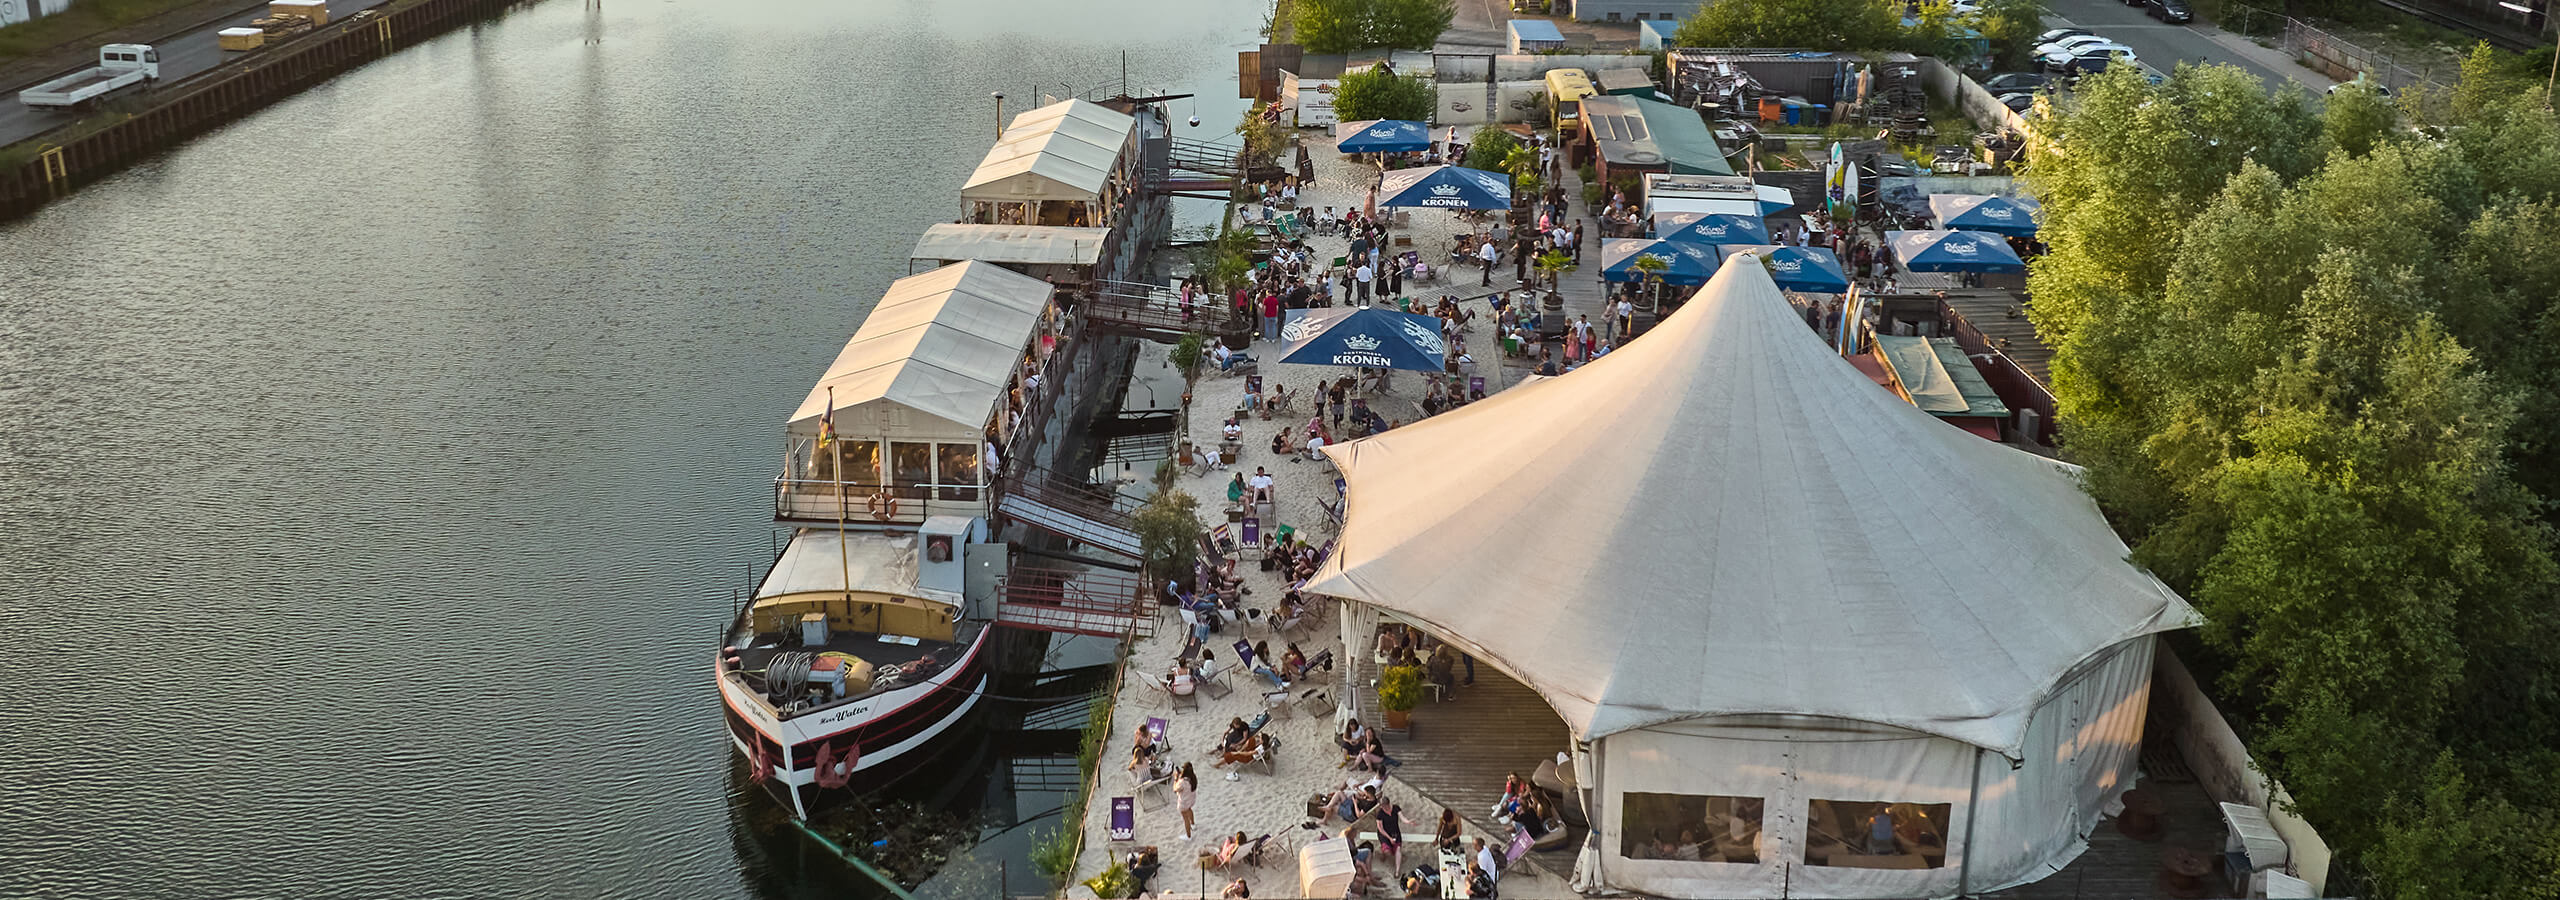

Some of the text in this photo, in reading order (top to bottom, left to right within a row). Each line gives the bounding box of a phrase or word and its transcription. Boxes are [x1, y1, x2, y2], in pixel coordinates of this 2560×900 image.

[1422, 199, 1469, 207] KRONEN
[1333, 355, 1391, 367] KRONEN
[835, 706, 869, 722] Walter
